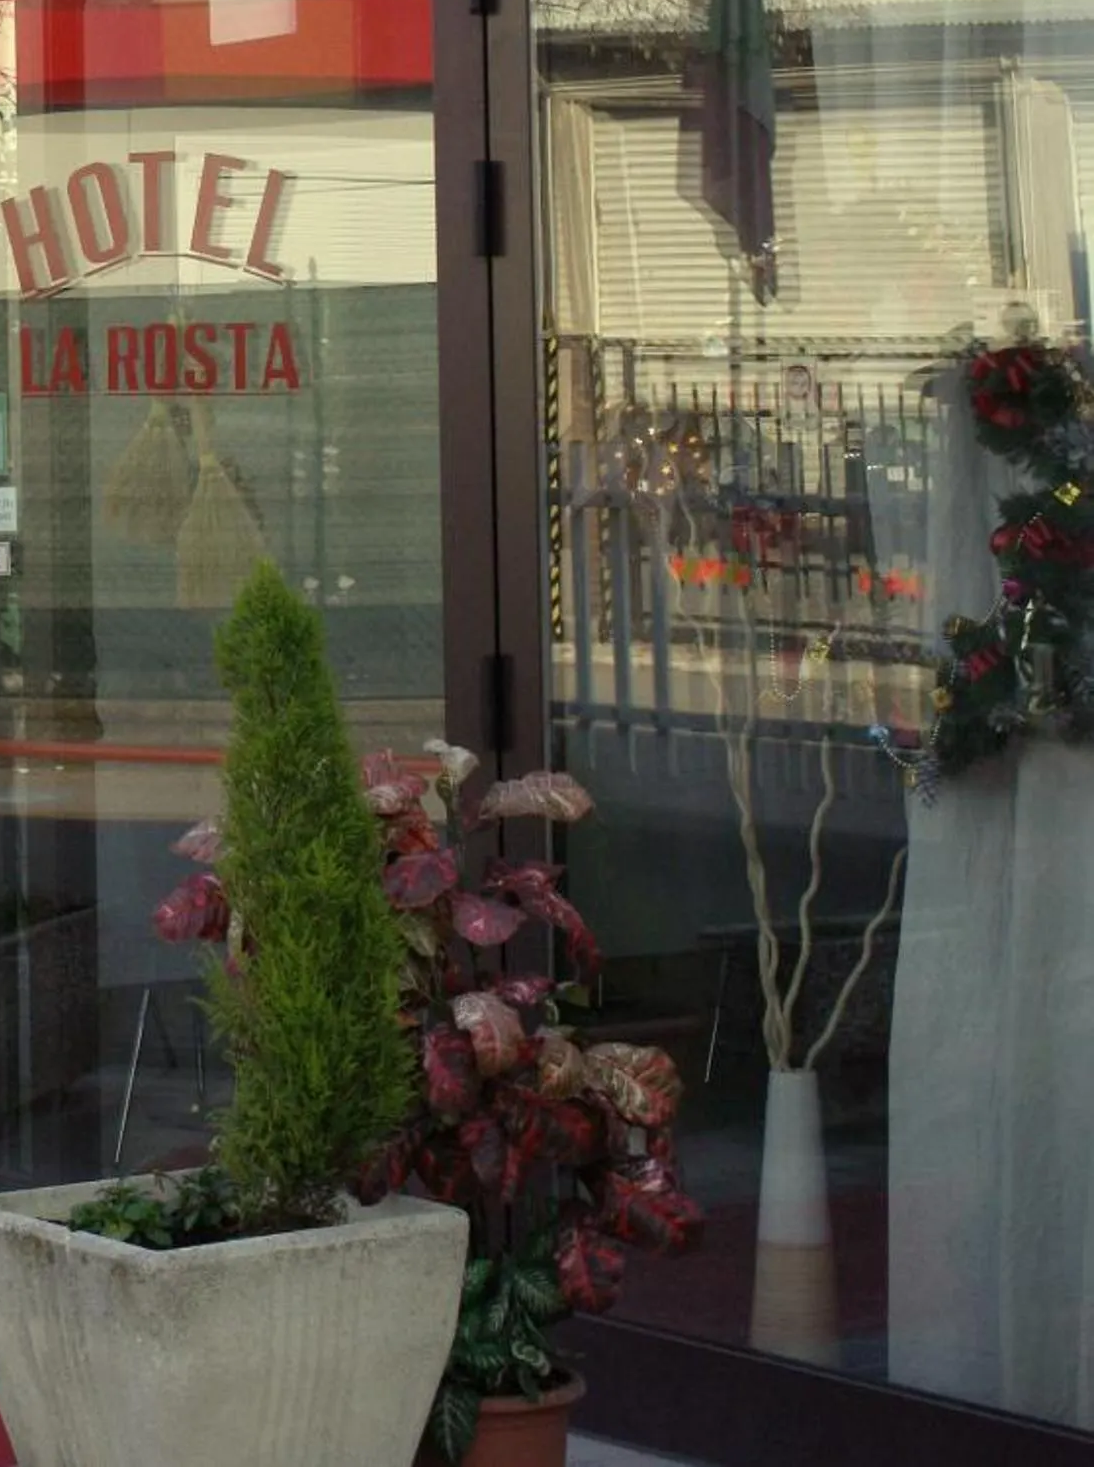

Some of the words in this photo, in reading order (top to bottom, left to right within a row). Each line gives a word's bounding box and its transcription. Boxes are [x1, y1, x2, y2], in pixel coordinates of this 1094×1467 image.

[1, 151, 288, 294] HOTEL
[19, 324, 87, 393] LA
[107, 322, 300, 392] ROSTA
